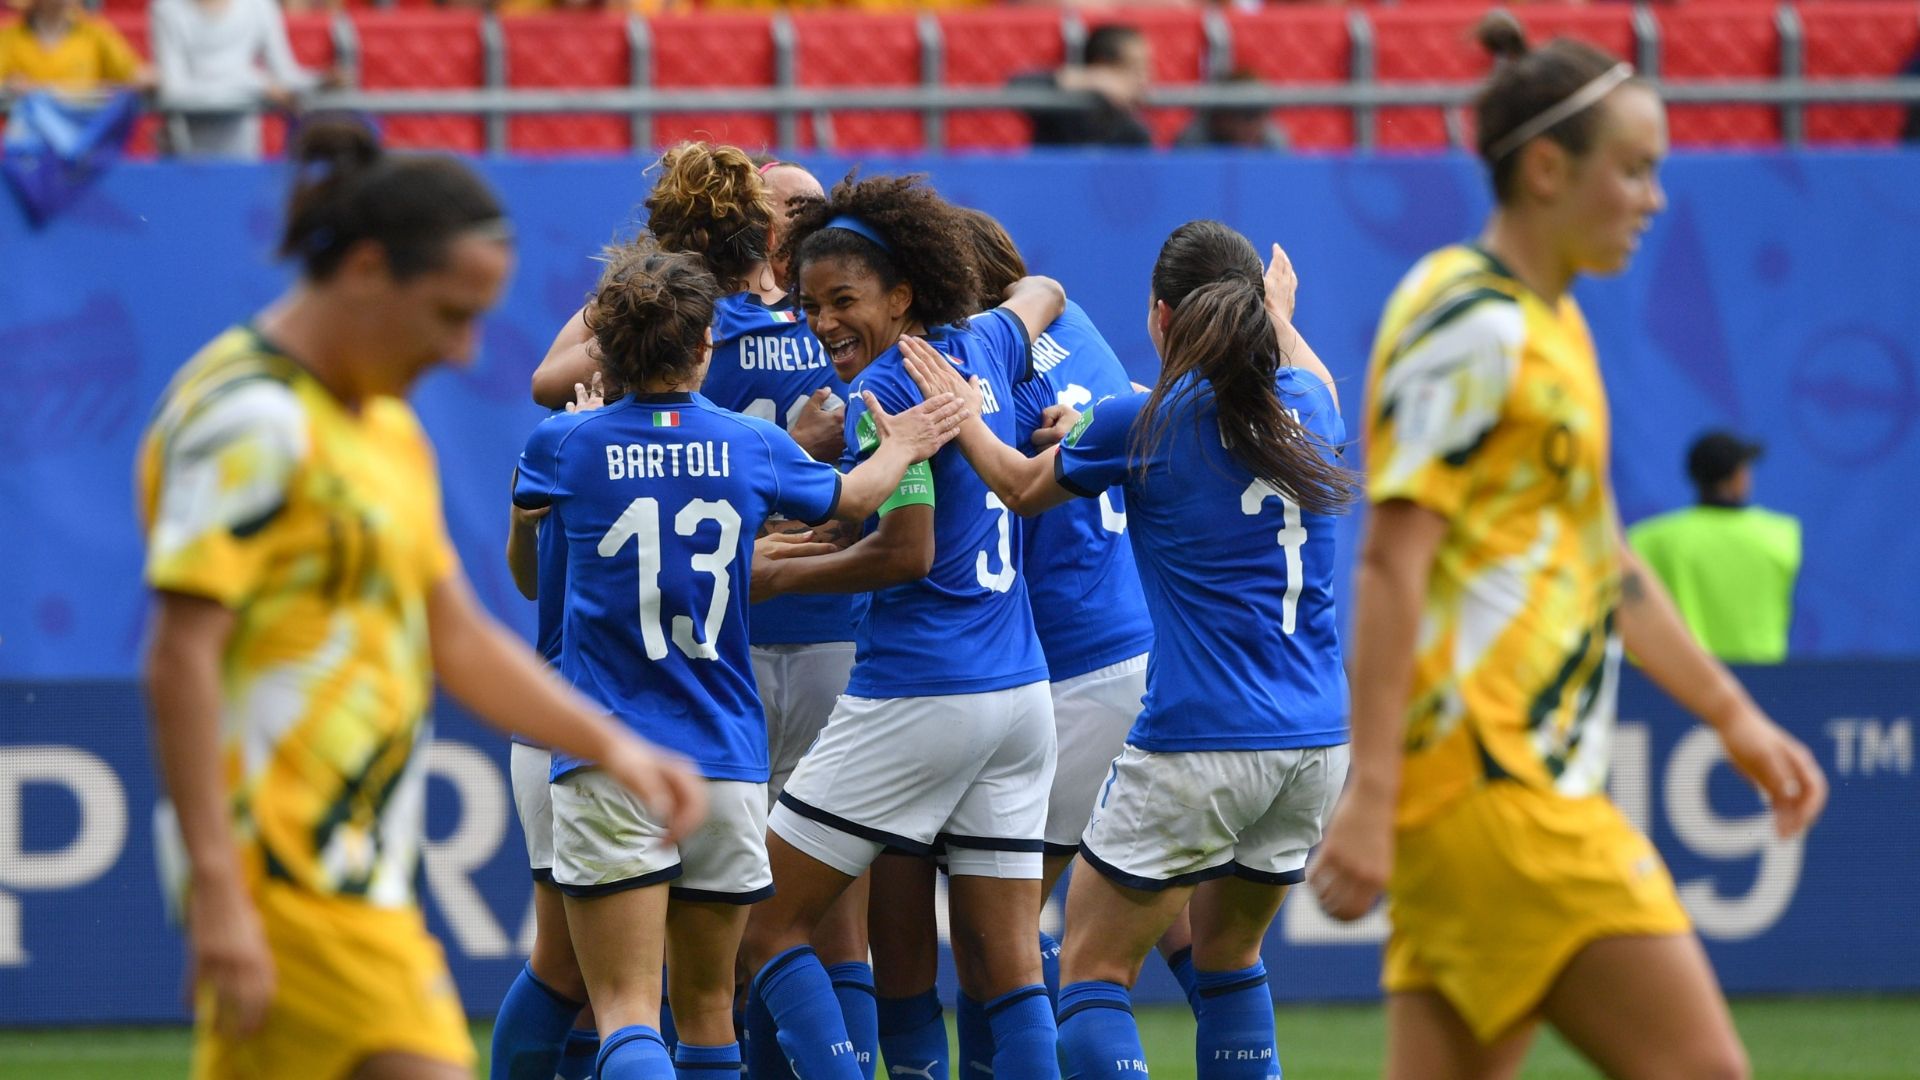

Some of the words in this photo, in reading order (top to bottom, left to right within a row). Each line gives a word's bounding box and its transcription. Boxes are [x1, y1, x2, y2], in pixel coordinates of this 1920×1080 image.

[739, 335, 827, 371] GIRELLI
[605, 440, 730, 480] BARTOLI
[900, 484, 928, 495] FIFA
[597, 497, 742, 661] 13
[1828, 718, 1913, 774] TM
[1214, 1047, 1272, 1060] ITALIA
